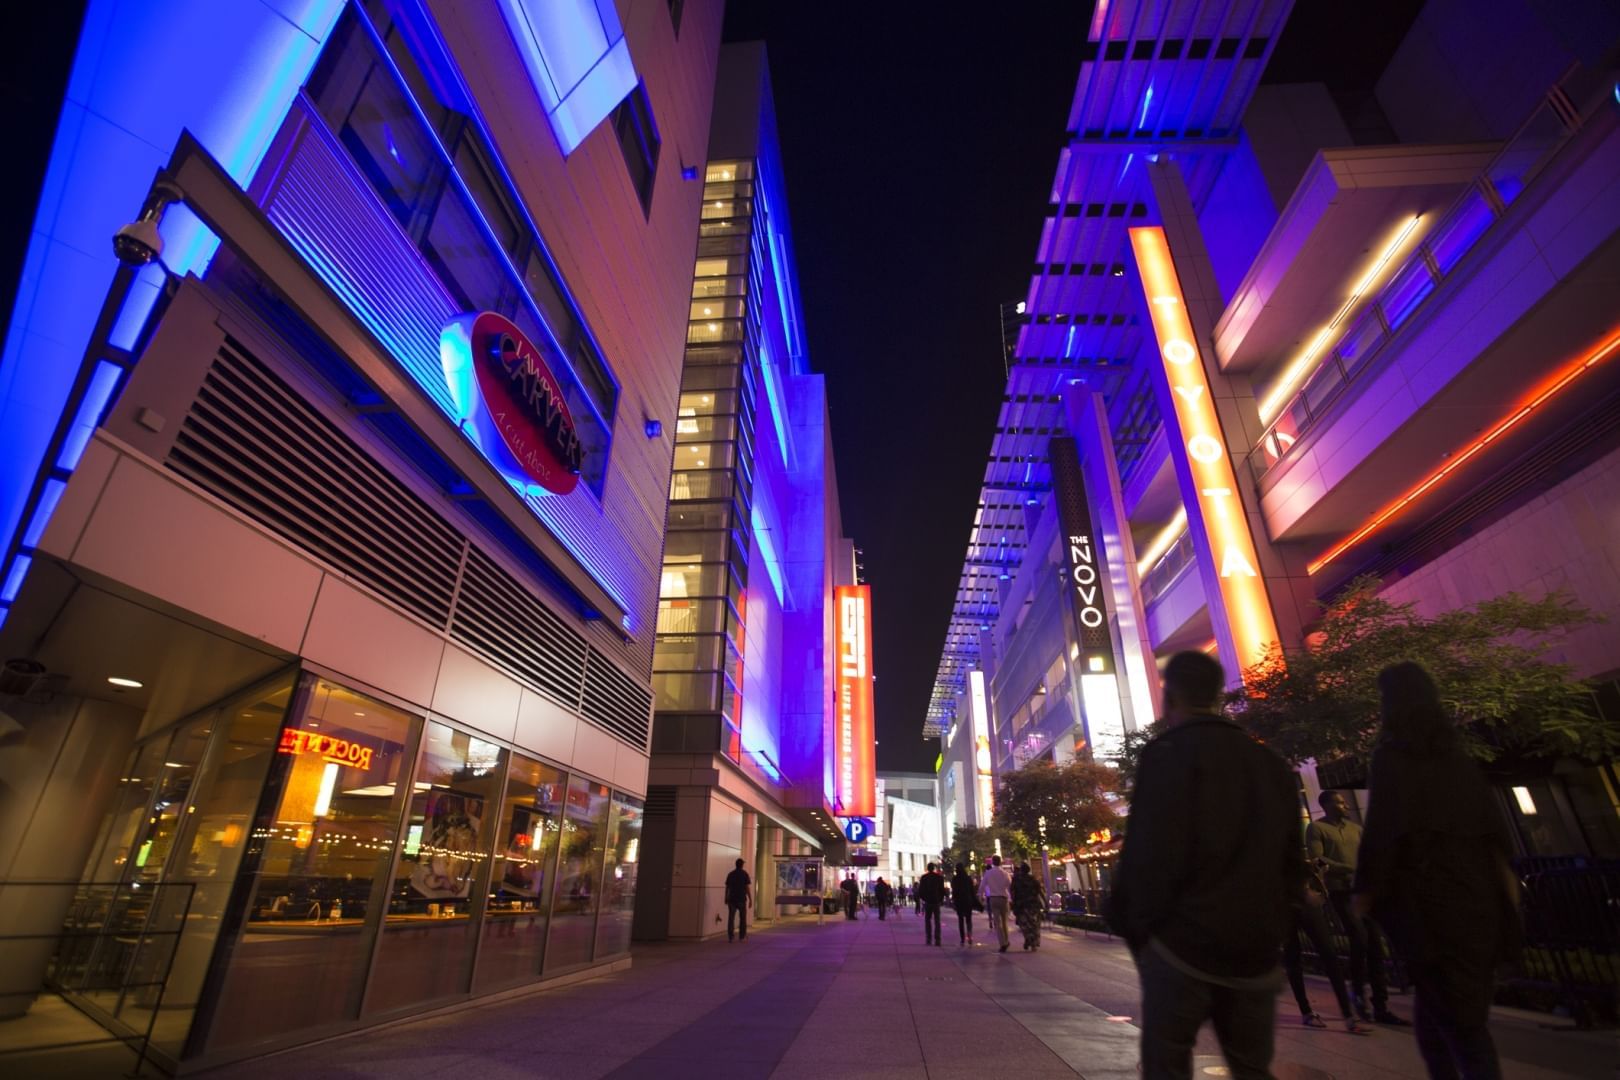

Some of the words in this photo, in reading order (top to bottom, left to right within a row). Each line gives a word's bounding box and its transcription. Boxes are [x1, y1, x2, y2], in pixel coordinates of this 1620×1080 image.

[1152, 296, 1257, 577] TOYOTA
[1069, 536, 1089, 544] THE
[1071, 545, 1102, 628] NOVO
[841, 596, 866, 678] ESPN
[851, 823, 863, 841] P
